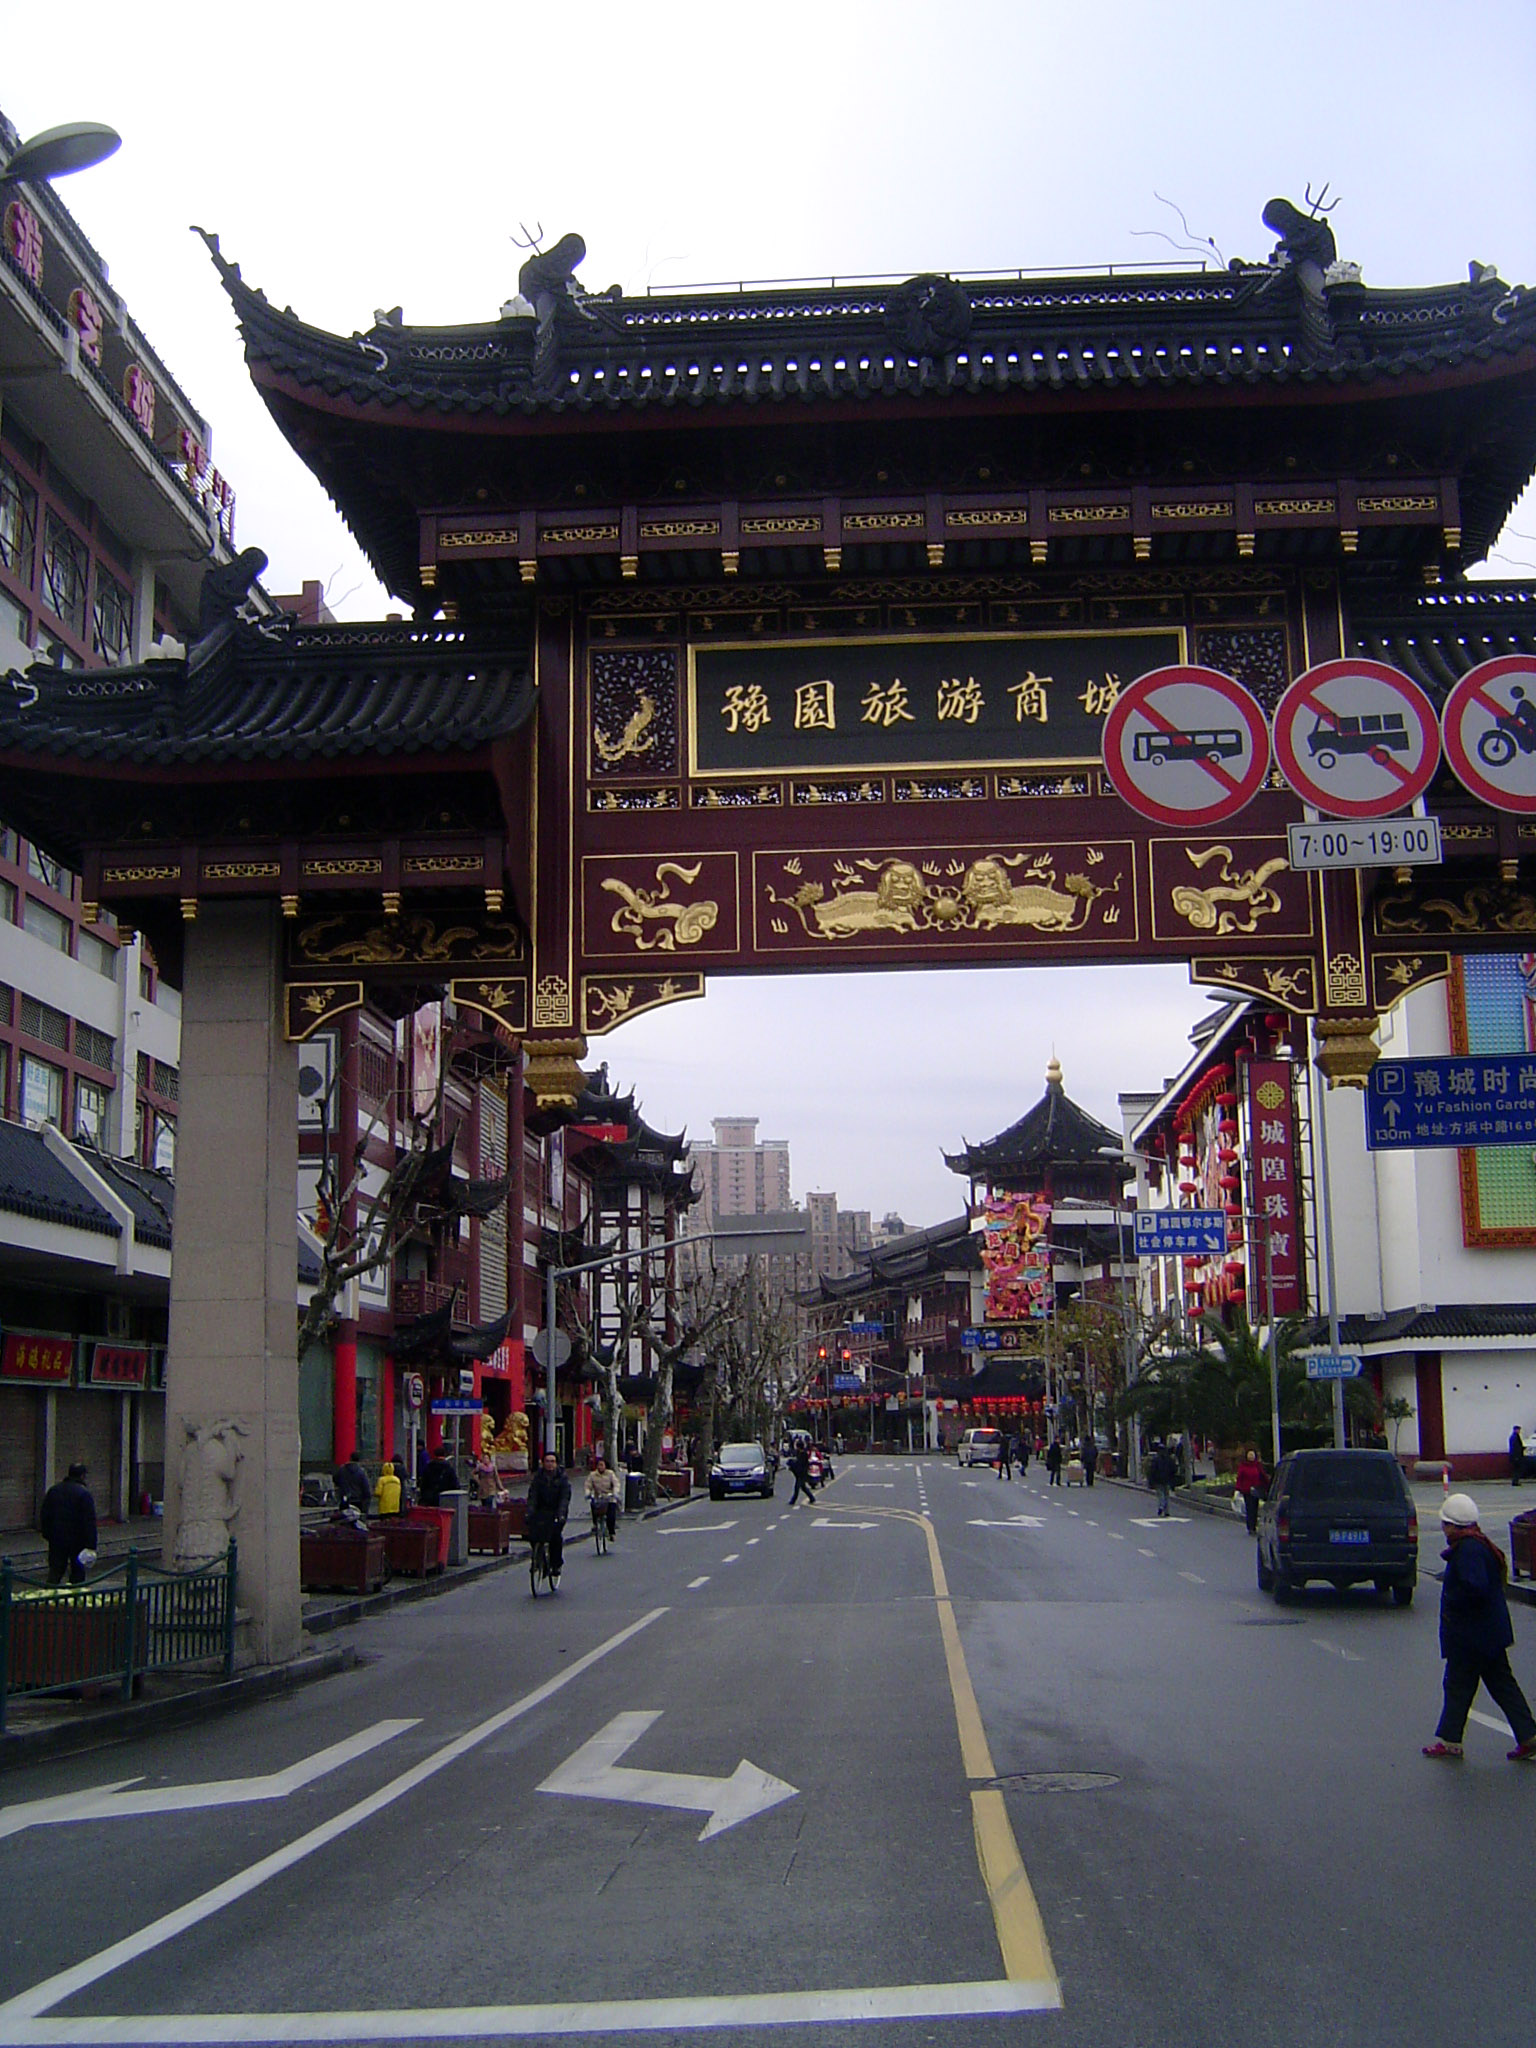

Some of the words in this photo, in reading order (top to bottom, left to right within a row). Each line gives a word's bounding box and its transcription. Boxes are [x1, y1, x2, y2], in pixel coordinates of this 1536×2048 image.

[1383, 1070, 1399, 1091] P
[1413, 1065, 1536, 1098] 豫城时尚
[1414, 1102, 1433, 1114] Yu
[1437, 1099, 1492, 1113] Fashion
[1375, 1128, 1411, 1141] 130m
[1141, 1216, 1152, 1230] P
